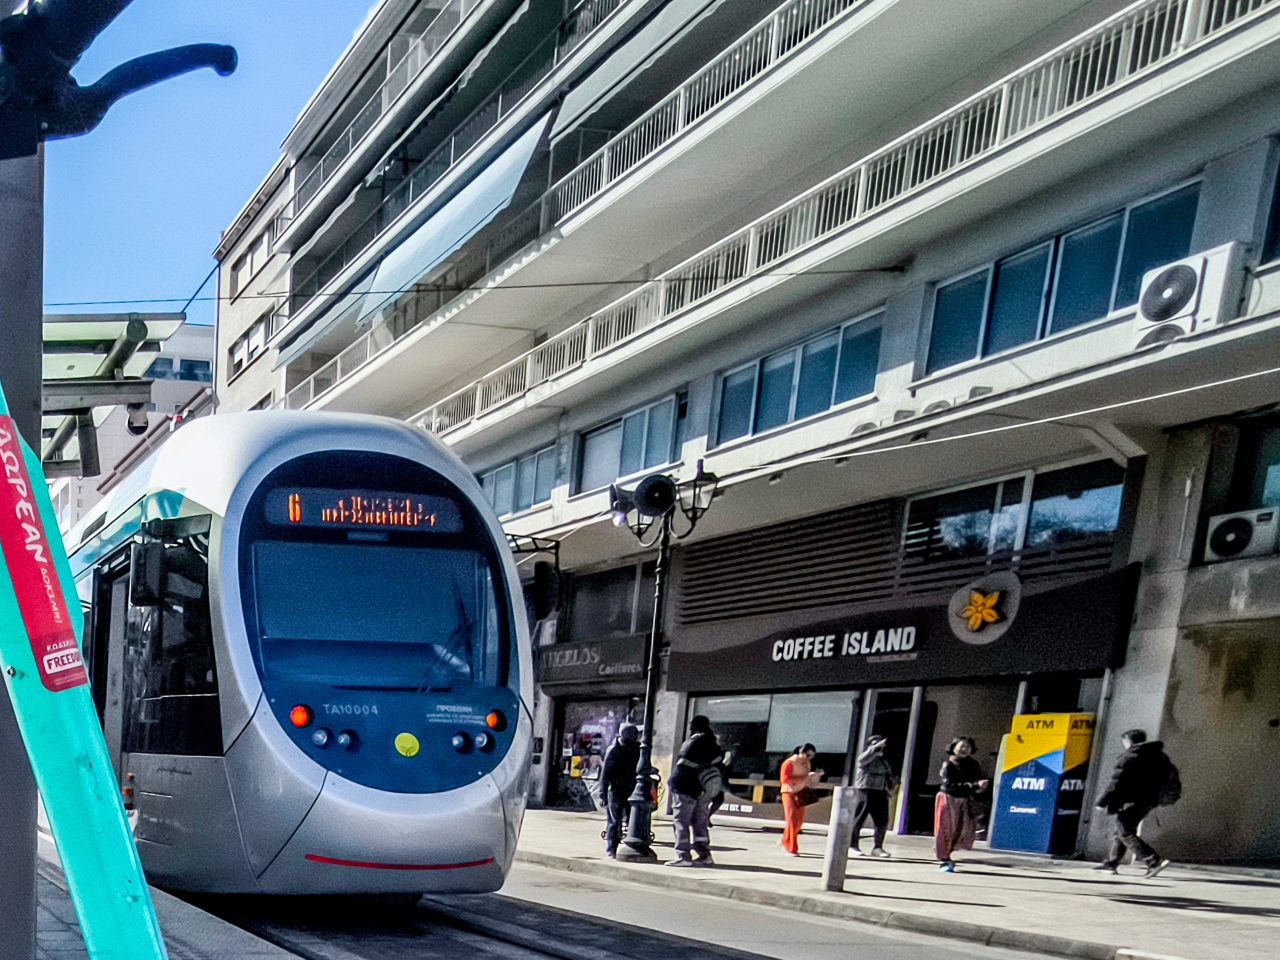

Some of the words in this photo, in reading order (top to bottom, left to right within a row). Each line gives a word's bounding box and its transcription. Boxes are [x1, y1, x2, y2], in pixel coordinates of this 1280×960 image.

[288, 493, 301, 523] 6
[772, 634, 836, 662] COFFEE
[841, 626, 916, 656] ISLAND
[323, 703, 379, 715] TA10004
[1025, 720, 1054, 730] ATM
[1011, 777, 1046, 791] ATM
